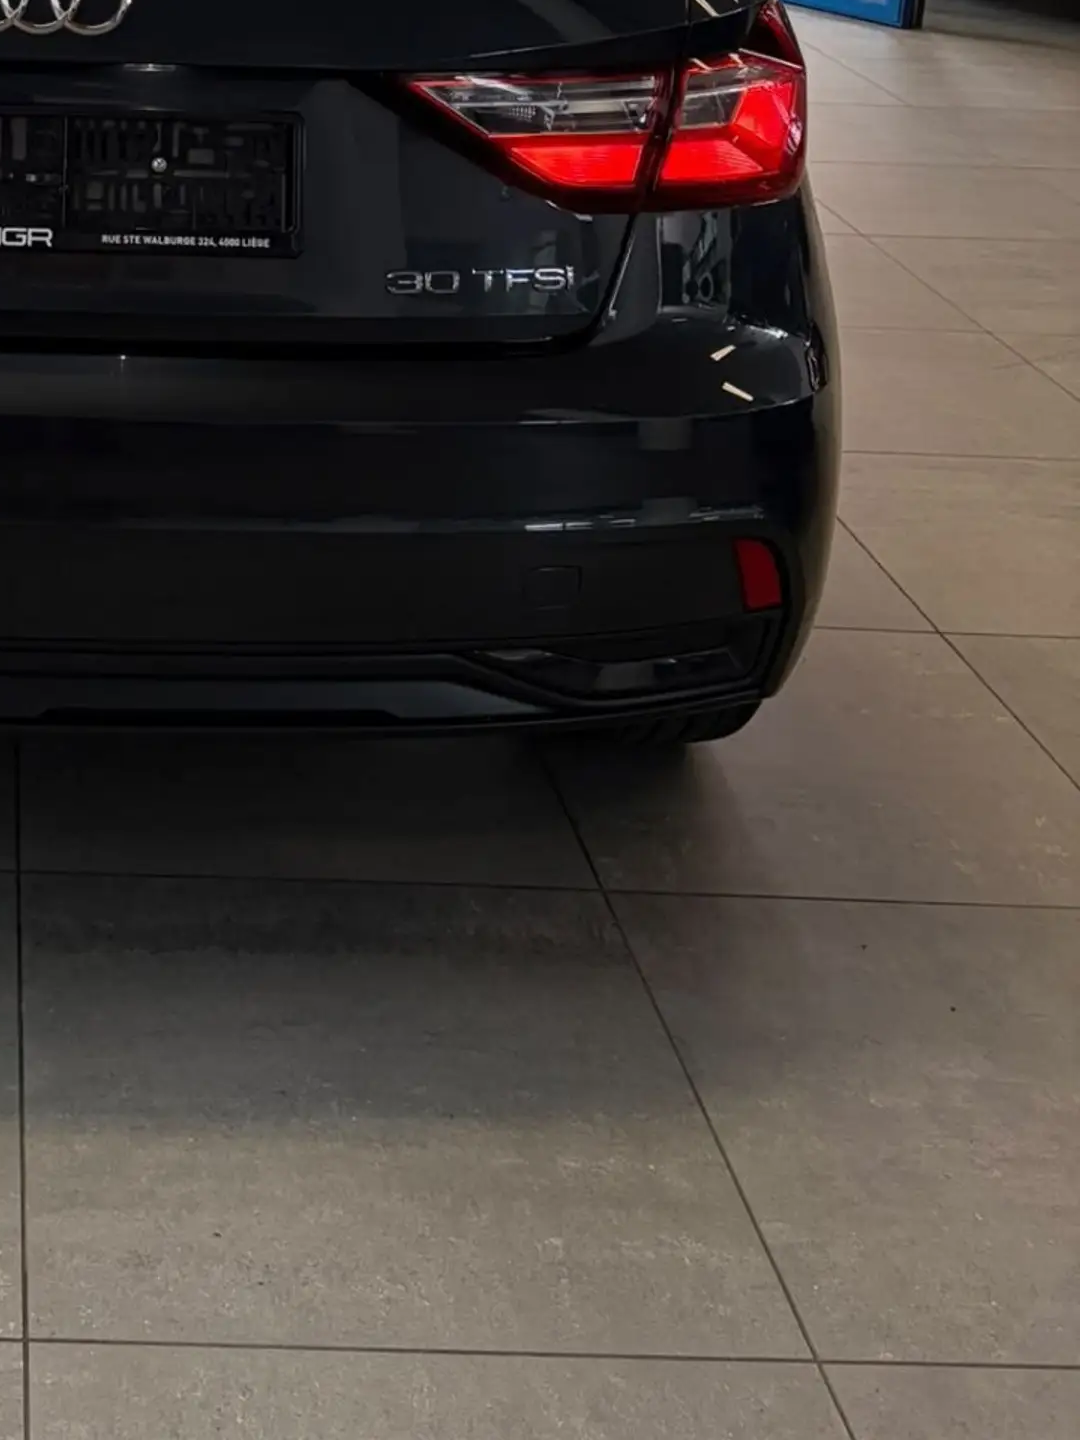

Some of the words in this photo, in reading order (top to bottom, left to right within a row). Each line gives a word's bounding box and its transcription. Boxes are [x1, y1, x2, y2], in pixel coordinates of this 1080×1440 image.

[101, 233, 121, 245] RUE
[122, 234, 142, 245] STE
[142, 235, 196, 247] WALBURGE
[218, 237, 241, 247] 4000
[386, 270, 461, 295] 30
